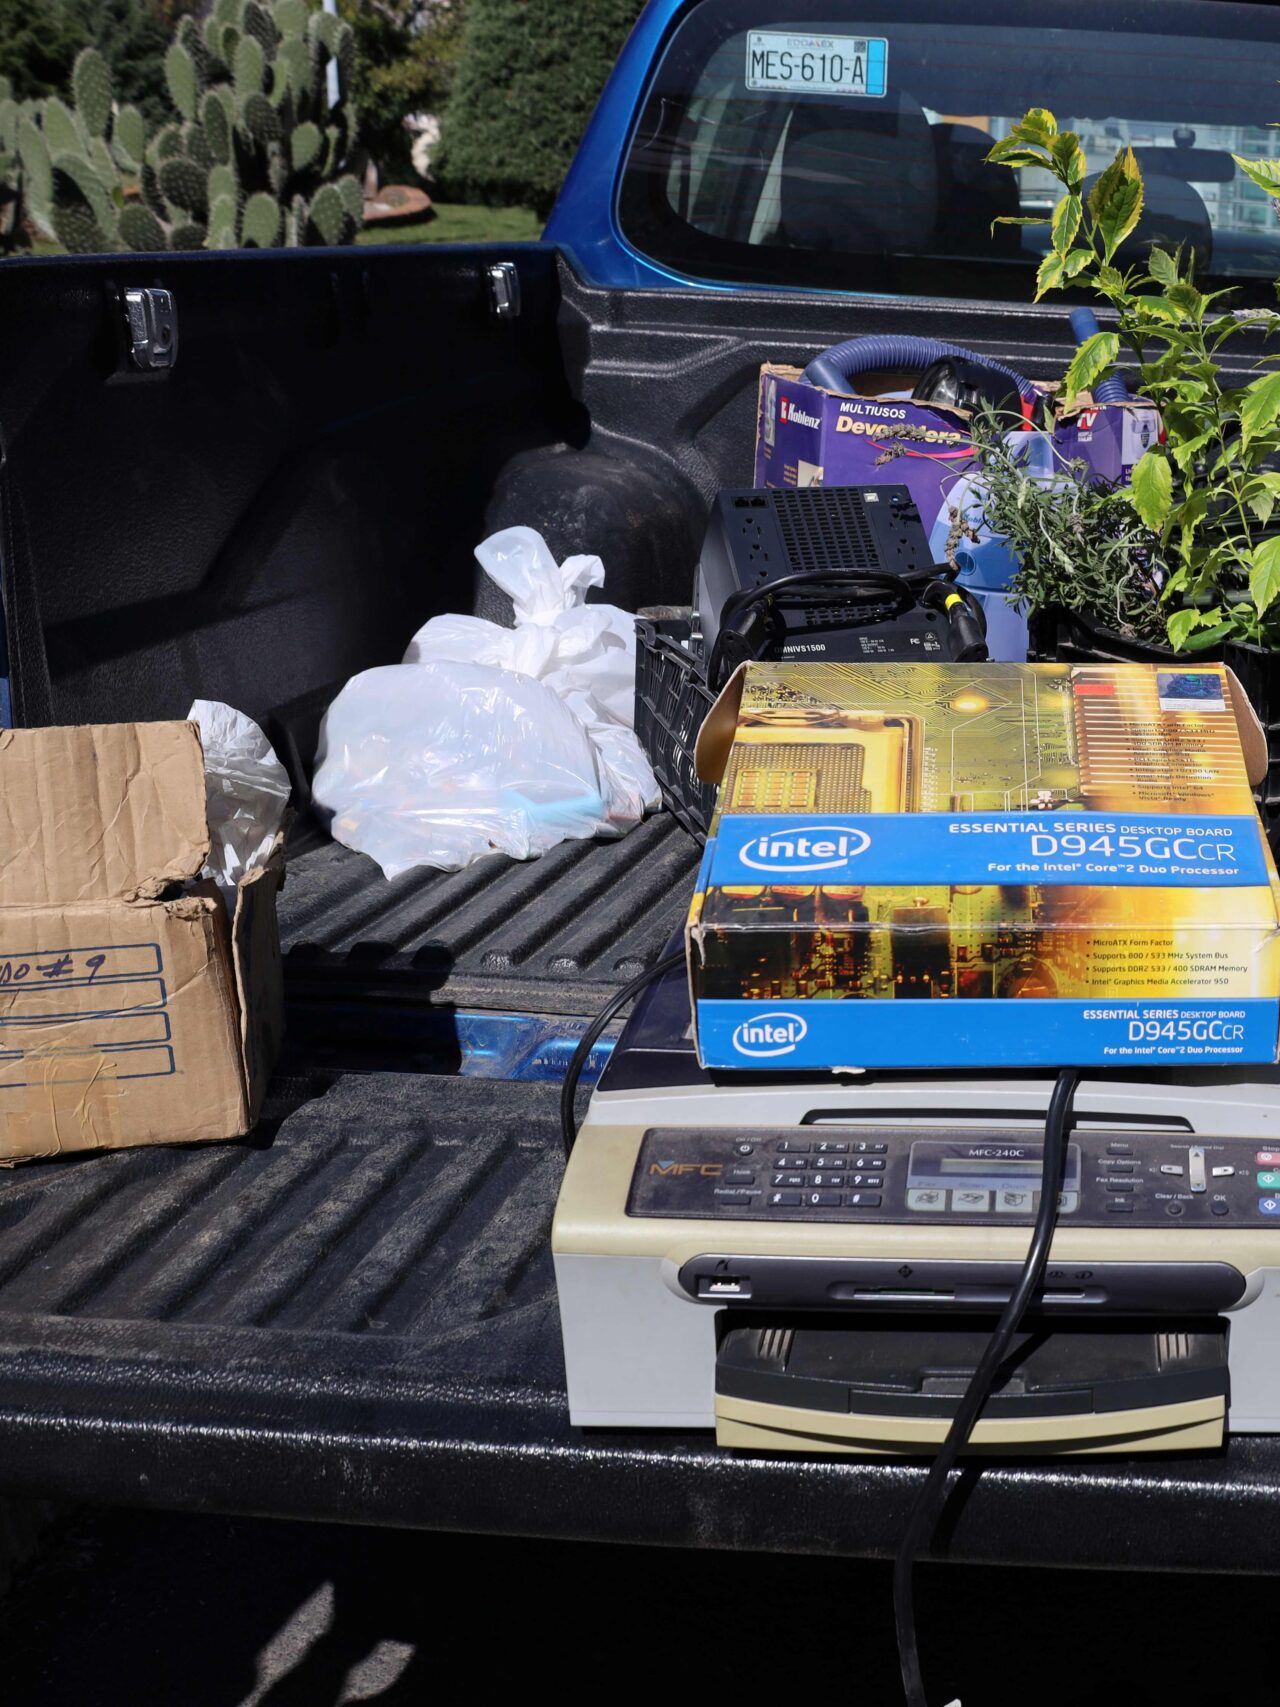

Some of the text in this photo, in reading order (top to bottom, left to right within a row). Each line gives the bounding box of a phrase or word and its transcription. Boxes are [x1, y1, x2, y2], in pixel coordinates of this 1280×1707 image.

[751, 50, 864, 84] MES-610-A
[840, 402, 907, 419] MULTIUSOS
[788, 403, 820, 430] Koblenz
[774, 643, 826, 654] OMNIVS1500
[949, 822, 1233, 837] ESSENTIAL SERIES DESKTOP BOARD
[757, 836, 849, 858] intel
[988, 863, 1012, 872] For
[1015, 862, 1040, 872] the
[1139, 864, 1167, 874] Duo
[1171, 865, 1240, 875] Processor
[1093, 952, 1126, 960] Supports
[1185, 952, 1213, 960] System
[85, 954, 106, 985] 9
[1092, 965, 1126, 973] Supports
[1218, 965, 1248, 973] Memory
[1113, 978, 1145, 986] Graphics
[1083, 1009, 1246, 1020] ESSENTIAL SERIES DESKTOP BOARD
[742, 1022, 795, 1043] intel
[1103, 1046, 1117, 1055] For
[1119, 1046, 1133, 1054] the
[1187, 1046, 1203, 1054] Duo
[1204, 1046, 1244, 1054] Processor
[784, 1141, 789, 1150] 1
[820, 1142, 828, 1150] 2
[859, 1142, 866, 1150] 3
[968, 1150, 1025, 1158] MFC-240C
[778, 1158, 786, 1166] 4
[817, 1158, 825, 1166] 5
[856, 1158, 864, 1167] 6
[649, 1163, 724, 1176] MFC
[775, 1174, 784, 1184] 7
[814, 1175, 822, 1184] 8
[854, 1175, 862, 1185] 9
[811, 1193, 820, 1204] 0
